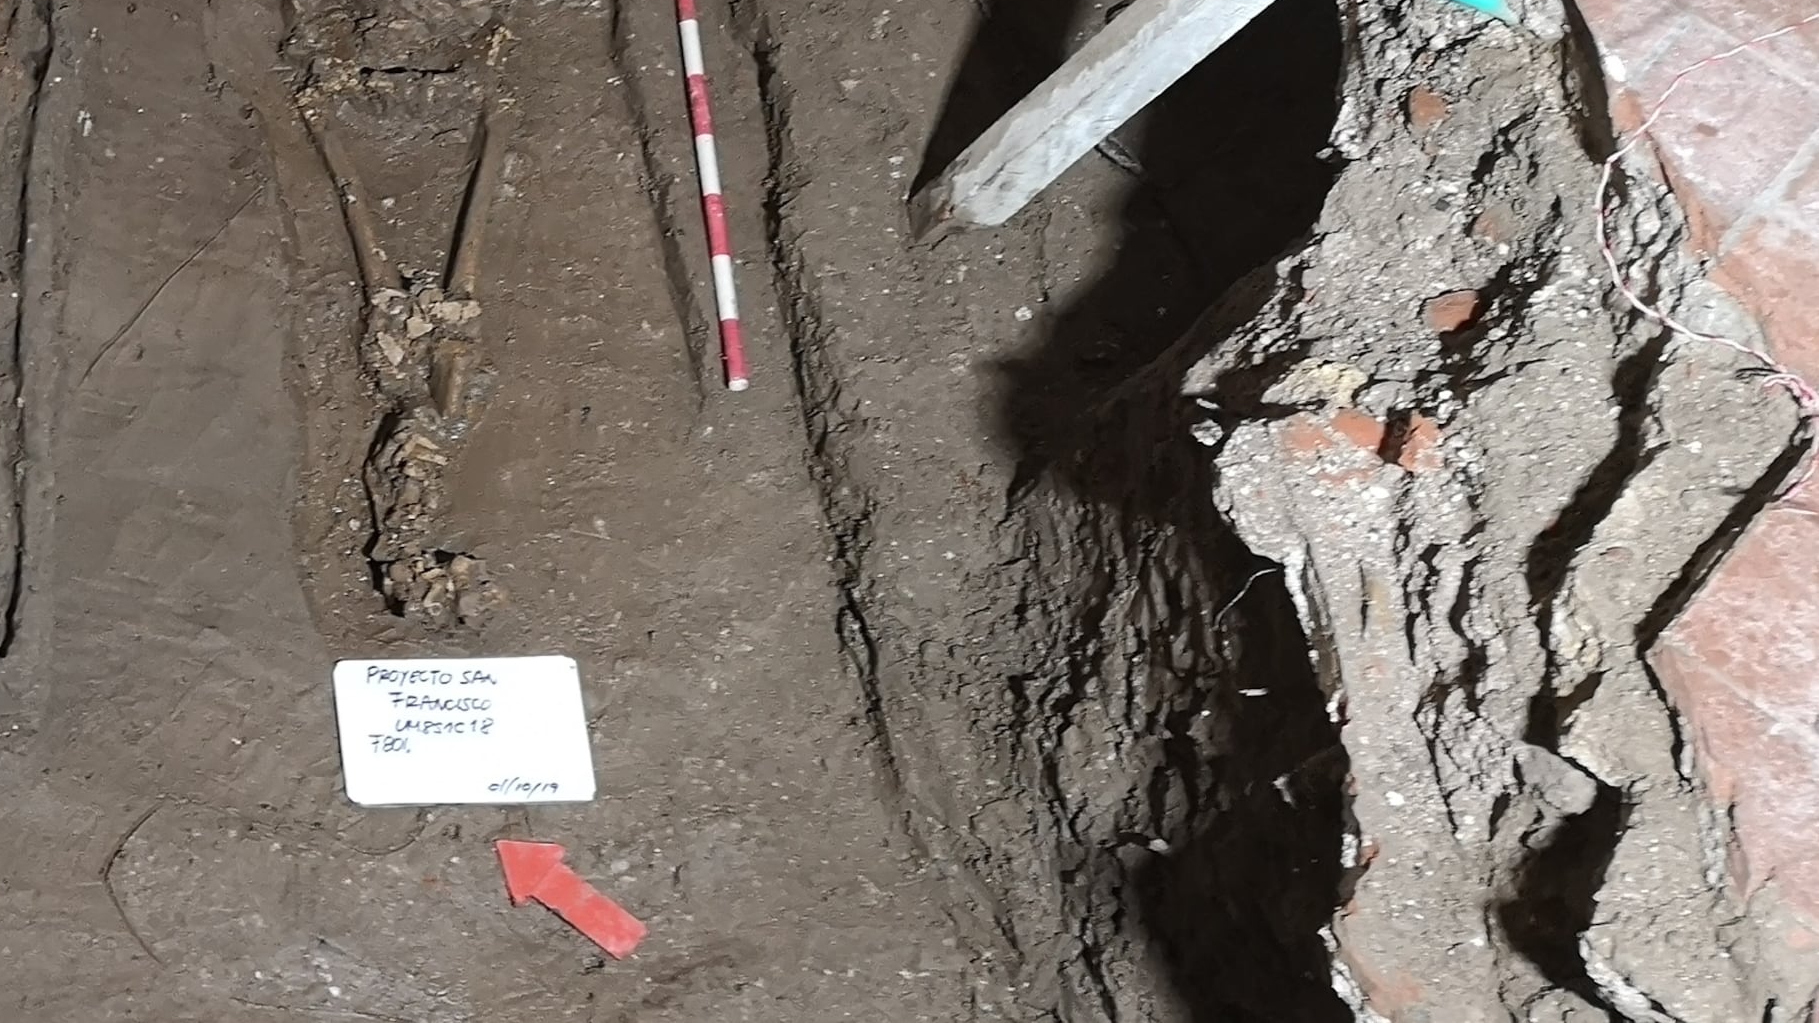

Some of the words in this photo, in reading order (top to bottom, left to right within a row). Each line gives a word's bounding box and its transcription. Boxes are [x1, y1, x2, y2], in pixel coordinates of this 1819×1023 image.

[367, 666, 452, 685] PROYECTO
[460, 670, 497, 684] SAN
[388, 692, 492, 711] FRANCISCO
